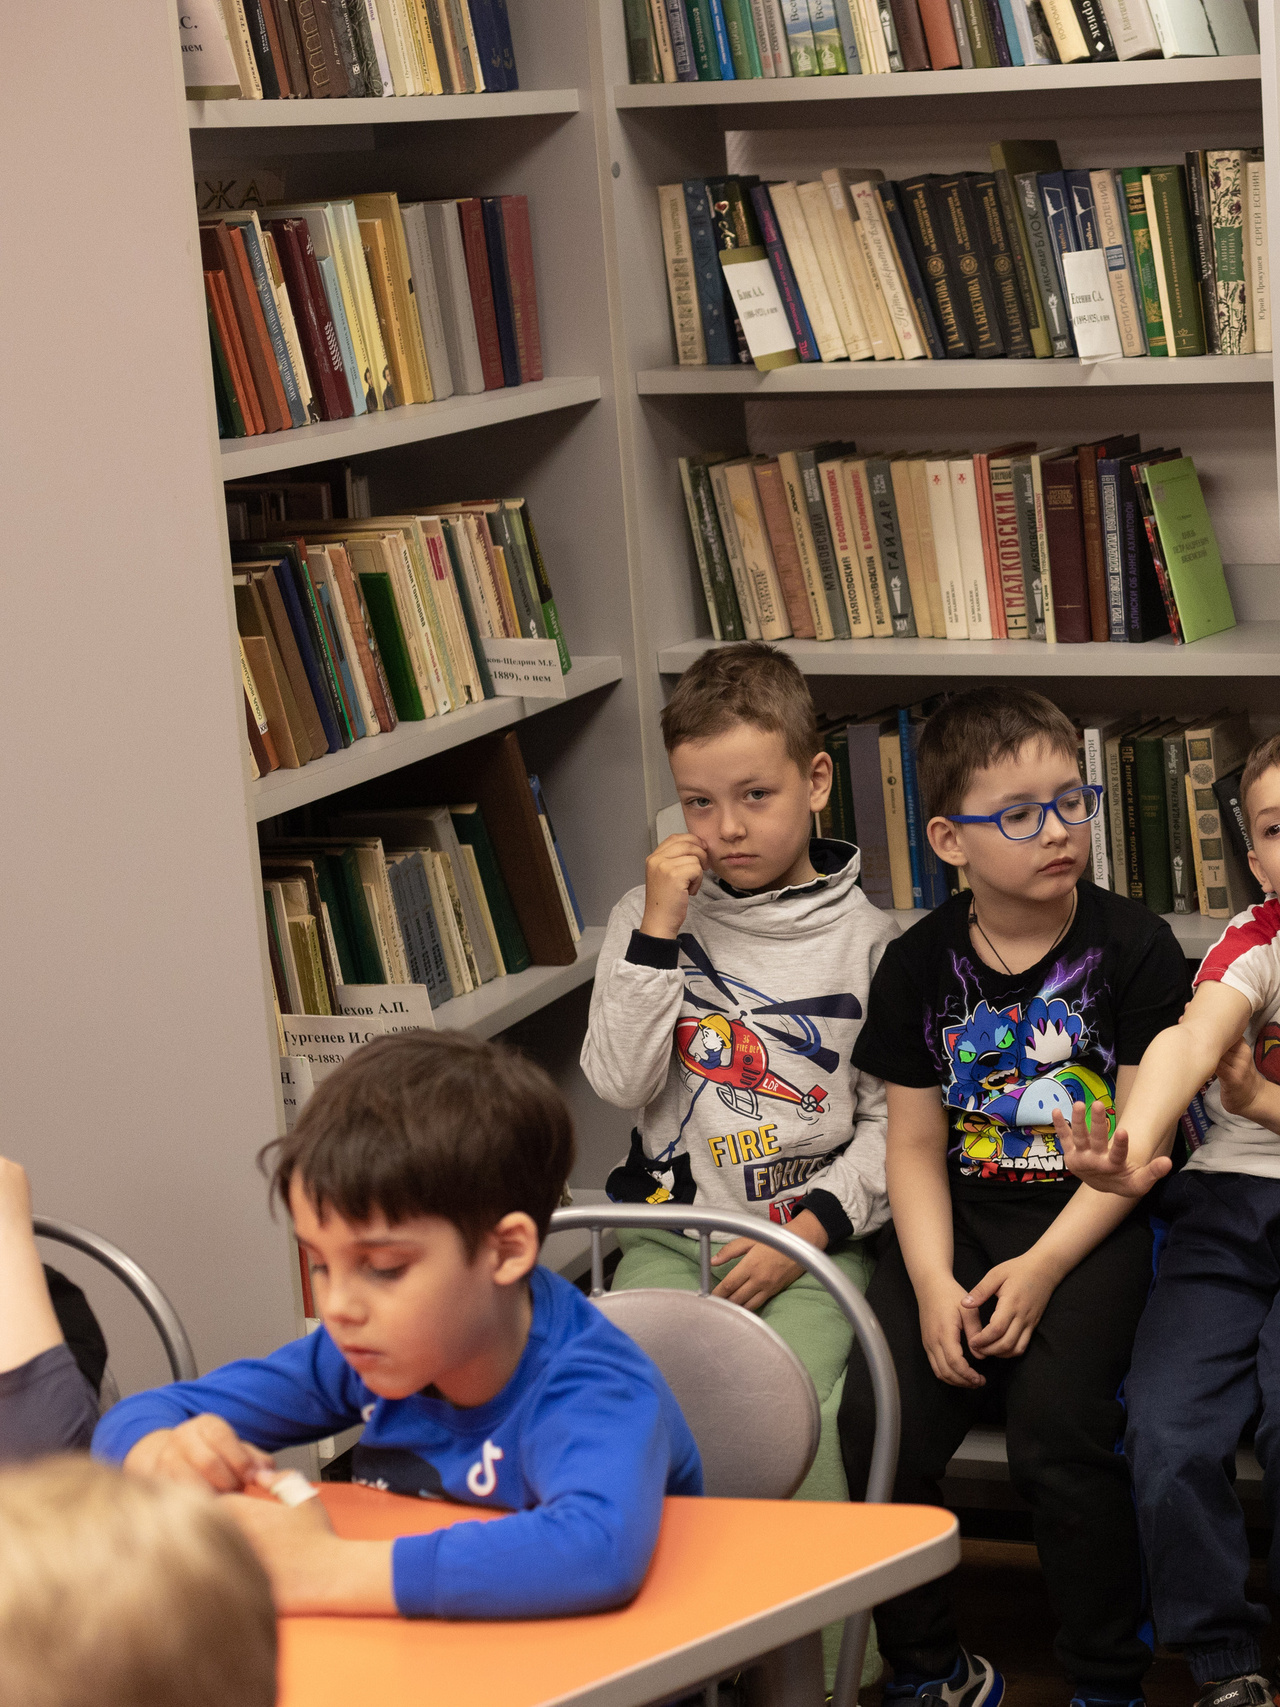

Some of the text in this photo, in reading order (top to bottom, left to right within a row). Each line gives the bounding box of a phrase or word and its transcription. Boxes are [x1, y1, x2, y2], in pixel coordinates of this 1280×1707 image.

[1099, 180, 1117, 245] ПОКОЛЕНИЙ
[1028, 211, 1054, 294] АЛЕКСАНДР БЛОК
[1219, 237, 1228, 263] МИРЕ
[1227, 231, 1237, 275] ЕСЕНИНА
[1251, 170, 1267, 321] Юрий Прокушев СЕРГЕЙ ЕСЕНИН
[935, 278, 960, 341] М.А.БЕКЕТОВА
[967, 277, 992, 342] М.А.БЕКЕТОВА
[1000, 278, 1025, 344] М.А.БЕКЕТОВА
[1070, 290, 1091, 305] Есенин
[1112, 272, 1134, 347] ВОСПИТАНИЕ
[825, 468, 863, 625] МАЯКОВСКИЙ В ВОСПОМИНАНИЯХ
[864, 542, 873, 550] В
[881, 500, 900, 570] ГАЙДАР
[1123, 501, 1140, 630] ЗАПИСКИ ОБ АННЕ АХМАТОВОЙ
[865, 555, 886, 625] МАЯКОВСКИЙ
[547, 605, 559, 634] БАРНС
[1111, 607, 1122, 624] ТРИ
[533, 675, 552, 683] нем
[1109, 753, 1119, 775] СЕДЛЕ
[1124, 764, 1134, 797] ЖИЗНИ
[1111, 782, 1120, 807] МОРЯК
[1127, 804, 1136, 828] ПУТИ
[1093, 820, 1105, 880] Консуэло де
[1114, 836, 1125, 866] ИРВИНГ
[378, 1001, 409, 1014] А.П.
[736, 1043, 749, 1054] FIRE
[762, 1078, 780, 1093] LDR
[707, 1123, 782, 1168] FIRE
[1213, 1690, 1240, 1705] GEOX
